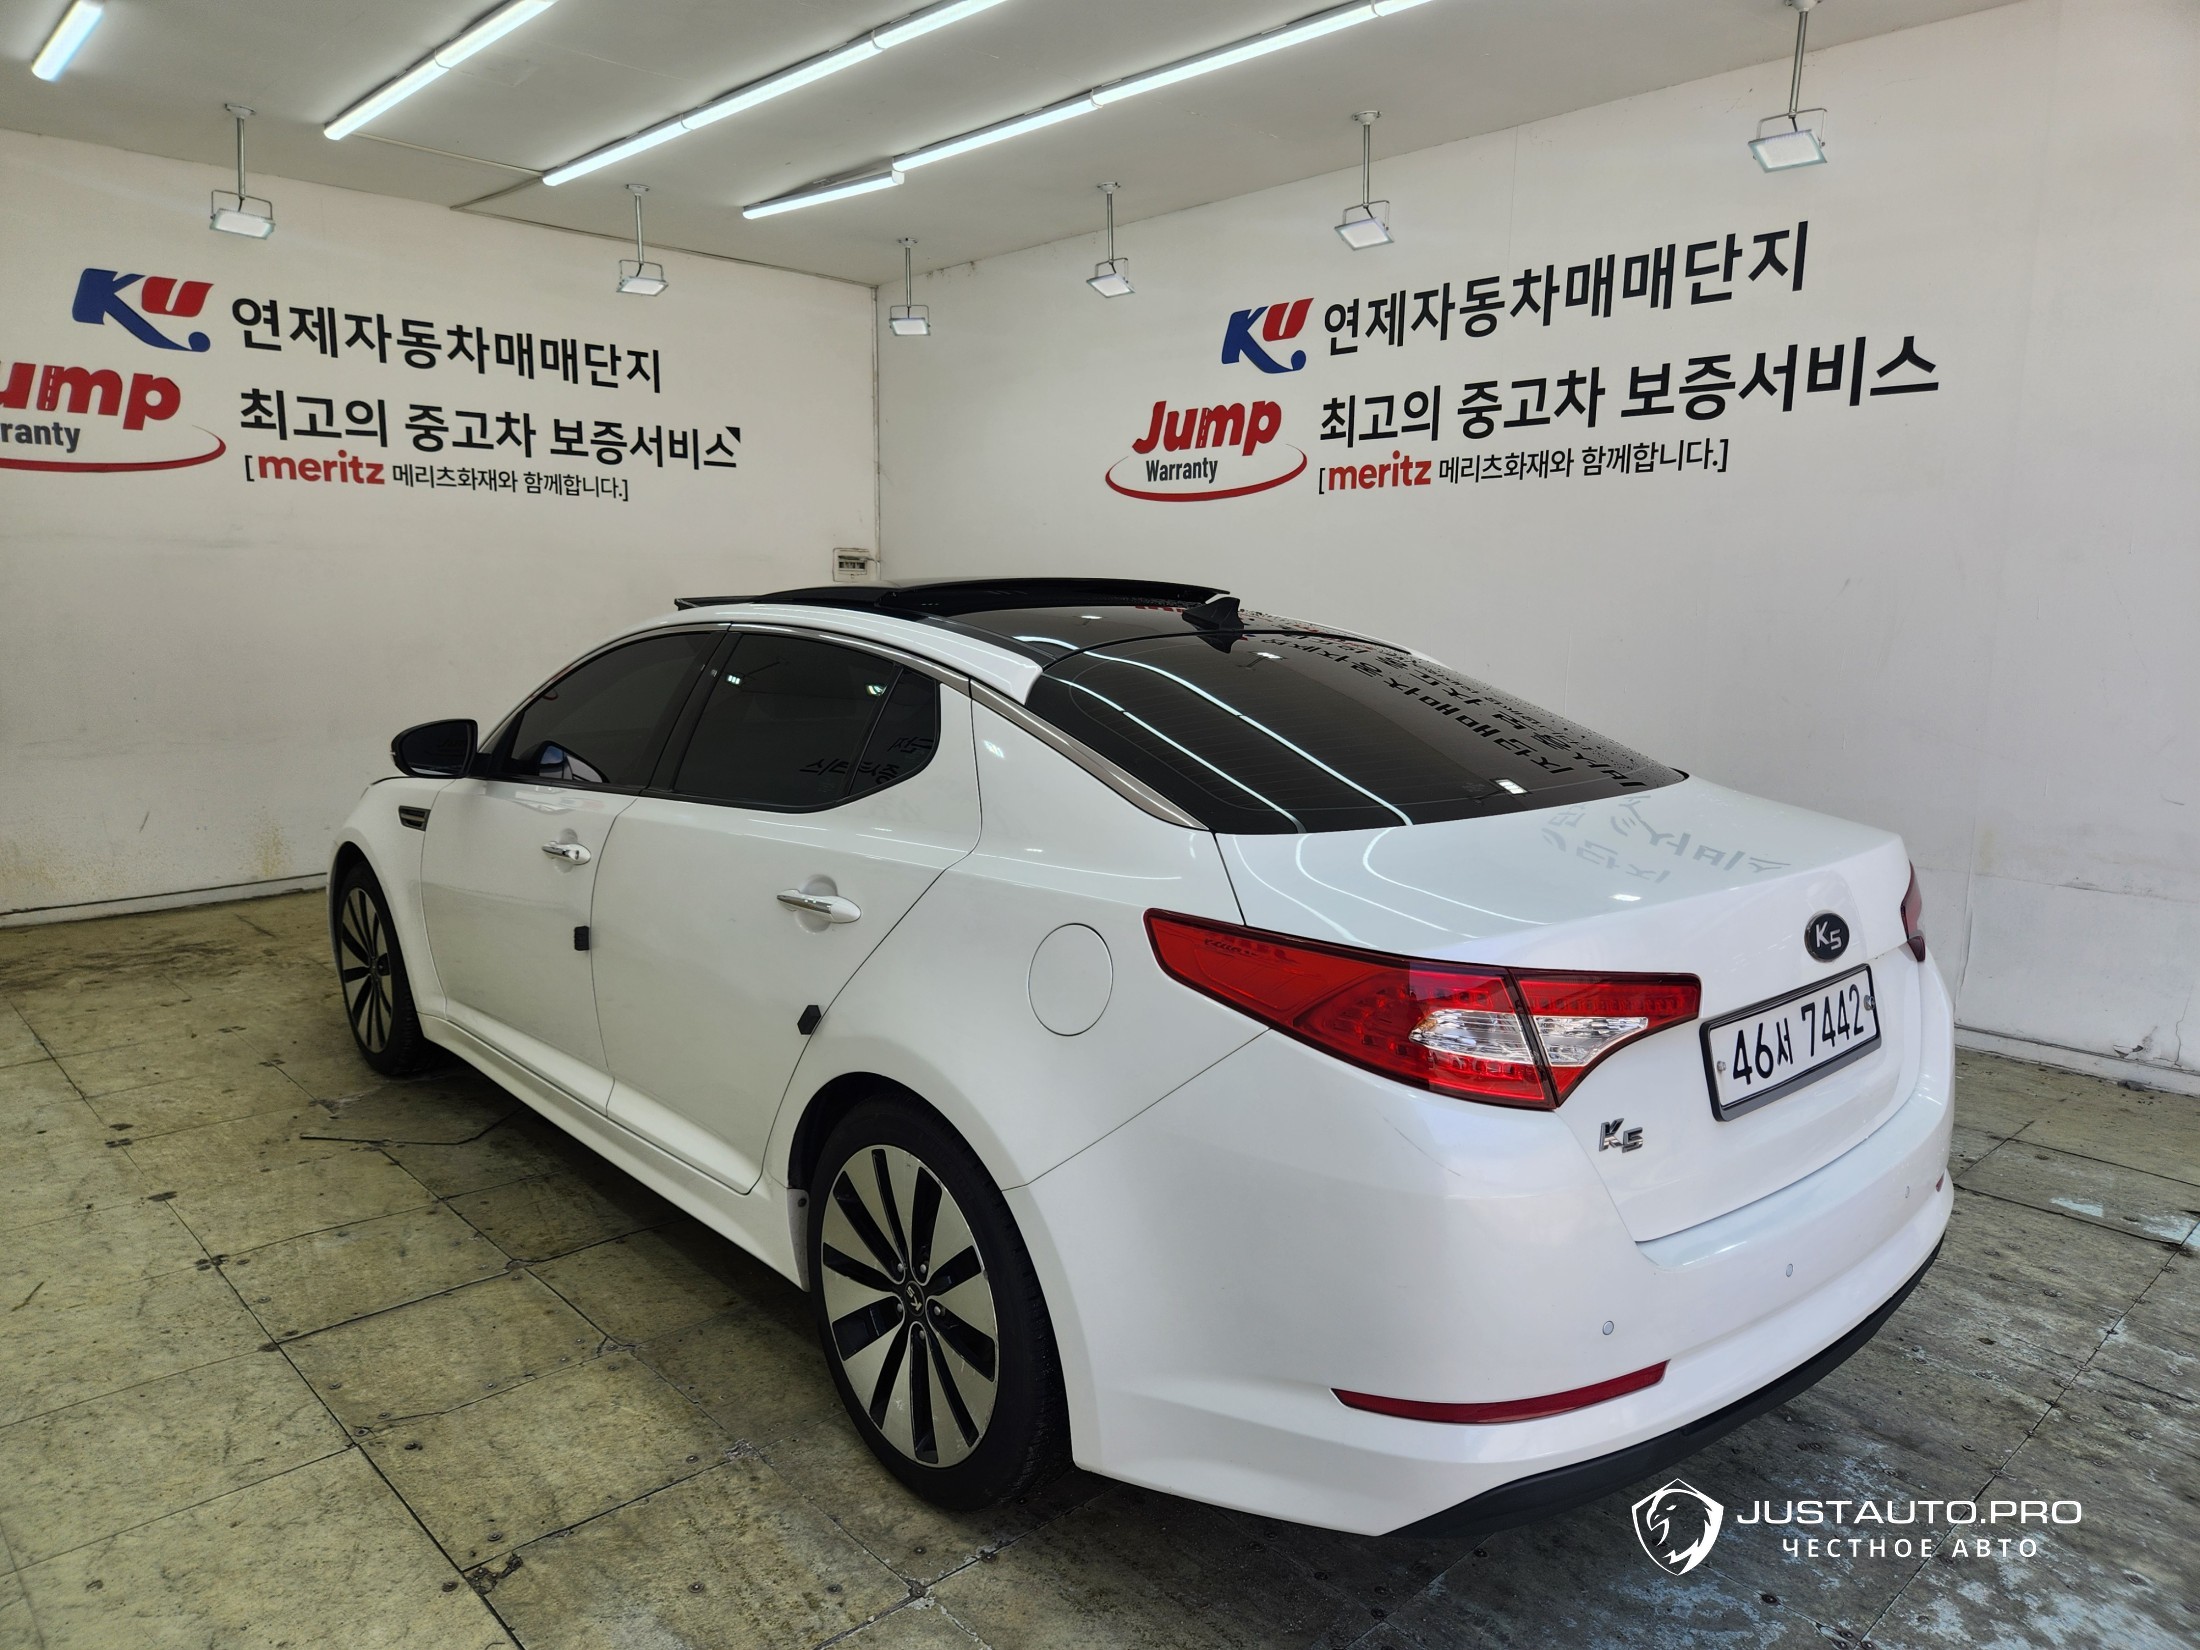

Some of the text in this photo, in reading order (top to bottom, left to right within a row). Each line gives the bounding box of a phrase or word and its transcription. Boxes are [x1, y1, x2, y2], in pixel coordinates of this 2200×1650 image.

[1324, 220, 1808, 358] 연제자동차매매단지
[232, 297, 661, 394] 연제자동차매매단지
[1320, 335, 1940, 448] 최고의 중고차 보증서비스
[240, 388, 741, 470] 최고의 중고차 보증서비스
[1132, 400, 1282, 456] Jump
[1438, 448, 1575, 485] 메리츠화재와
[1582, 438, 1729, 476] 함께합니다.]
[392, 463, 518, 493] 메리츠화재와
[523, 471, 628, 501] 함께합니다.]
[1146, 457, 1218, 484] Warranty
[1732, 984, 1865, 1086] 46서 7442
[1598, 1117, 1644, 1154] K5
